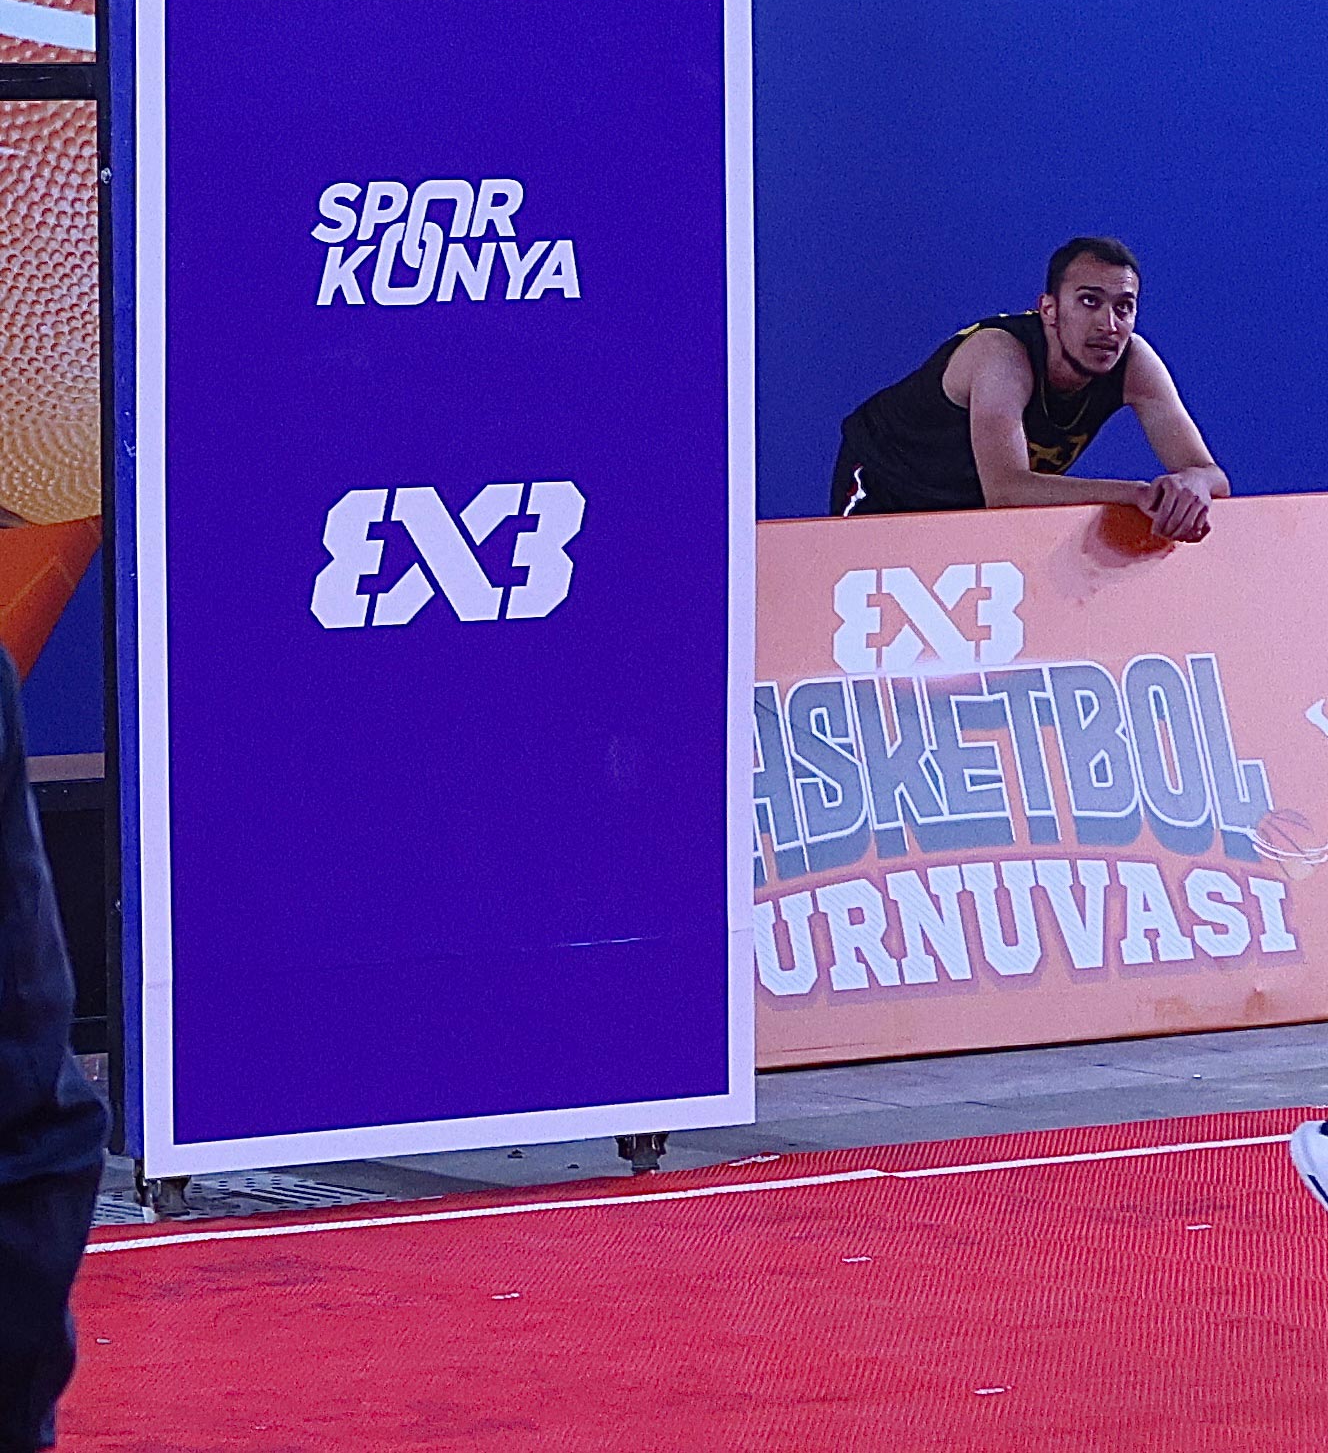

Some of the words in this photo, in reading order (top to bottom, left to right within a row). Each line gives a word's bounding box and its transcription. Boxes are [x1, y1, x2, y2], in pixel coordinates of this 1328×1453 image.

[311, 178, 524, 268] SPOR
[316, 222, 582, 306] KONYA
[753, 653, 1273, 867] ASKETBOL
[753, 859, 1298, 996] URNUVASI
